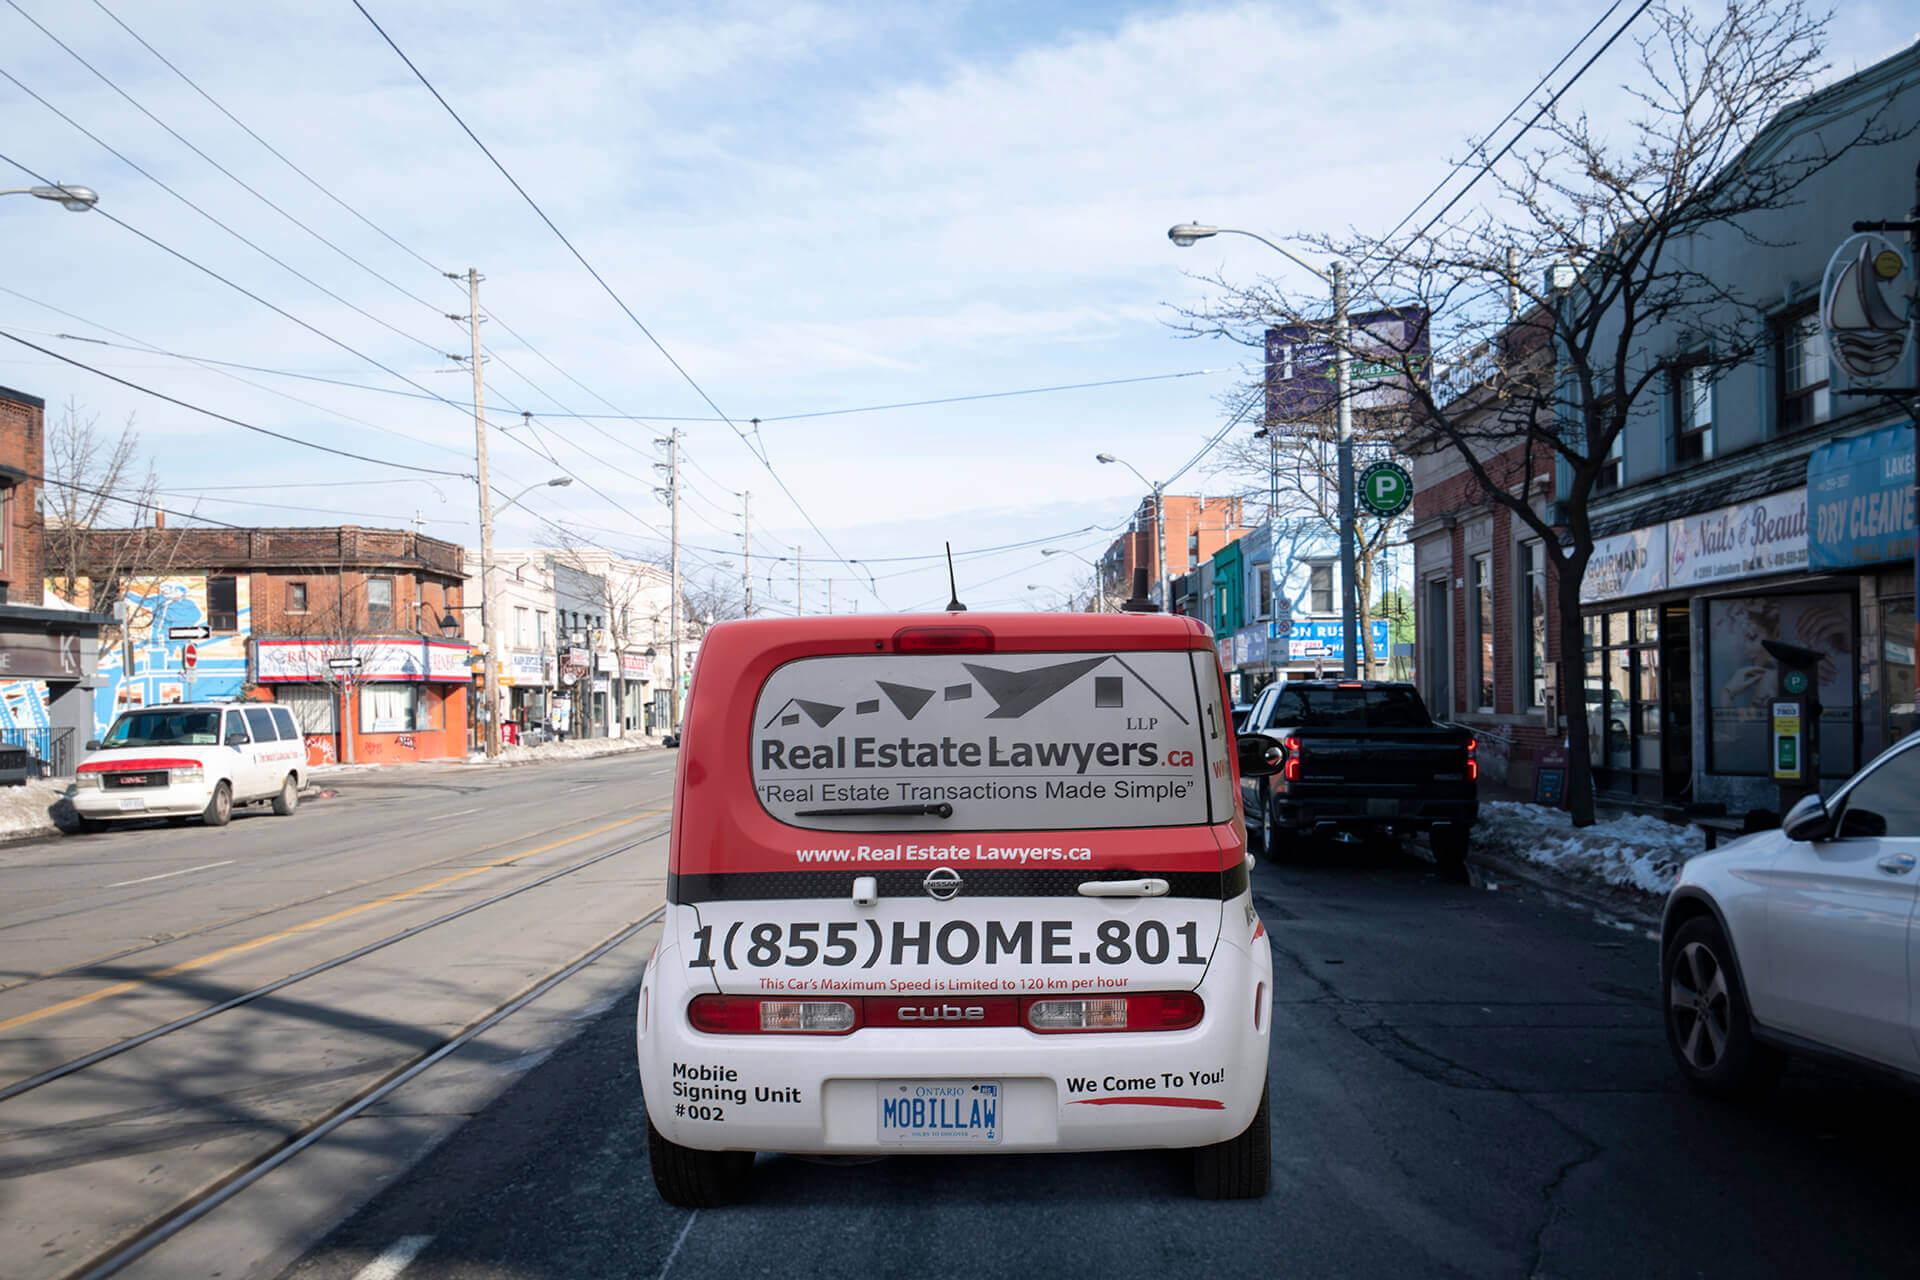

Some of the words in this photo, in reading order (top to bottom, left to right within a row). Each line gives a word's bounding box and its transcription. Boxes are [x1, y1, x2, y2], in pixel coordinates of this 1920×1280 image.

[1360, 463, 1410, 488] MUNICIPAL
[1376, 476, 1397, 498] P
[1360, 493, 1411, 516] PARKING
[1694, 513, 1735, 558] Nails
[1750, 504, 1809, 547] Beaut
[1817, 499, 1847, 545] DRY
[1588, 547, 1648, 578] GOURMAND
[1854, 544, 1882, 561] FULL
[1597, 578, 1624, 595] BAKERY
[1126, 717, 1159, 730] LLP
[762, 737, 845, 770] Real
[855, 736, 981, 768] Estate
[119, 775, 147, 784] GMC
[823, 784, 889, 801] Estate
[896, 781, 1037, 800] Transactions
[1046, 781, 1106, 798] Made
[906, 845, 970, 861] Estate
[976, 845, 1091, 864] Lawyers.ca
[927, 880, 962, 888] NISSAN
[689, 919, 1207, 970] 1(855)HOME.801
[760, 978, 785, 990] This
[788, 978, 818, 990] Car’s
[821, 978, 886, 991] Maximum
[890, 978, 931, 992] Speed
[934, 978, 945, 990] is
[949, 978, 998, 990] Limited
[1002, 979, 1016, 990] to
[1020, 978, 1044, 990] 120
[1047, 977, 1069, 990] km
[1072, 978, 1095, 992] per
[1097, 976, 1128, 988] hour
[898, 1004, 985, 1020] cube
[1066, 1077, 1097, 1093] We
[1103, 1075, 1156, 1091] Come
[1161, 1073, 1184, 1089] To
[1189, 1067, 1224, 1086] You!
[672, 1082, 747, 1105] Signing
[754, 1086, 802, 1103] Unit
[915, 1086, 965, 1097] ONTARIO
[675, 1104, 725, 1121] #002
[883, 1098, 997, 1129] MOBILLAW
